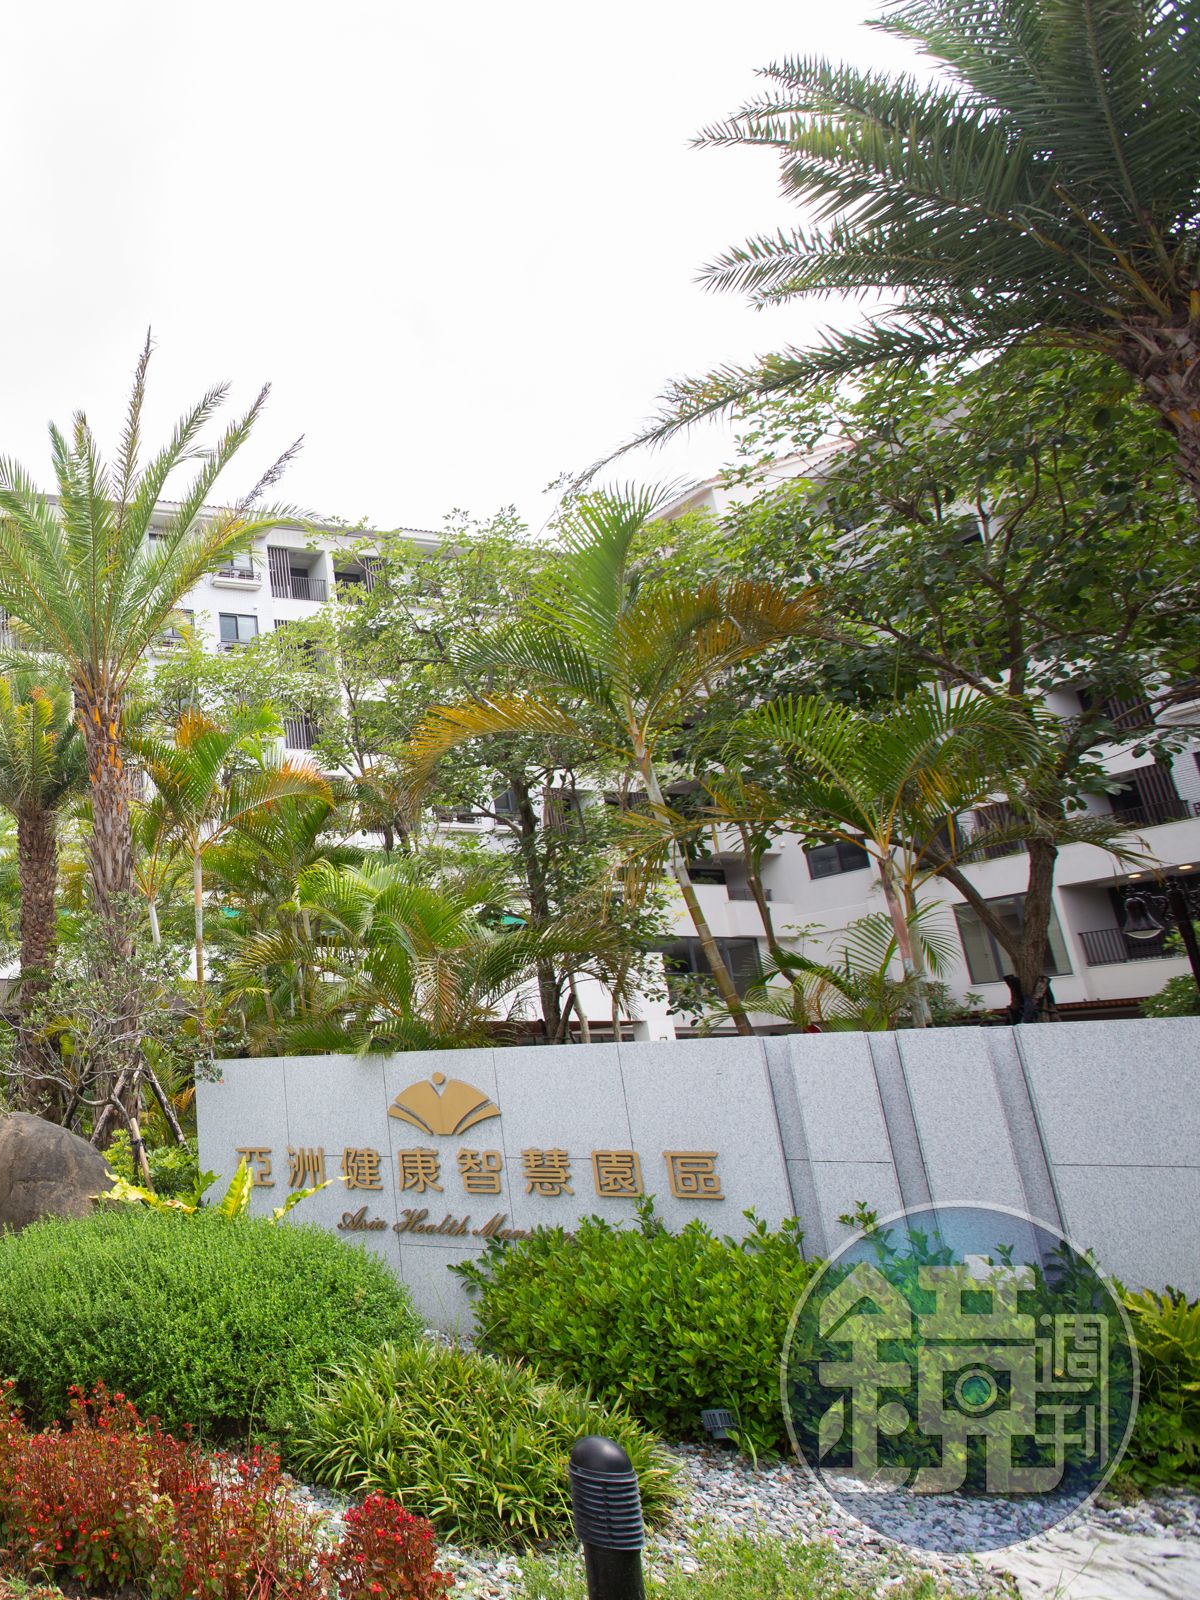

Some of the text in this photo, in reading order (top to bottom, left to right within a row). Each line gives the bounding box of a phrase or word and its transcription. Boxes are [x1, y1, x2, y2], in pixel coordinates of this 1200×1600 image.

[235, 1146, 725, 1200] 亞洲健康智慧園區
[337, 1205, 387, 1232] Asia
[393, 1208, 471, 1237] Health
